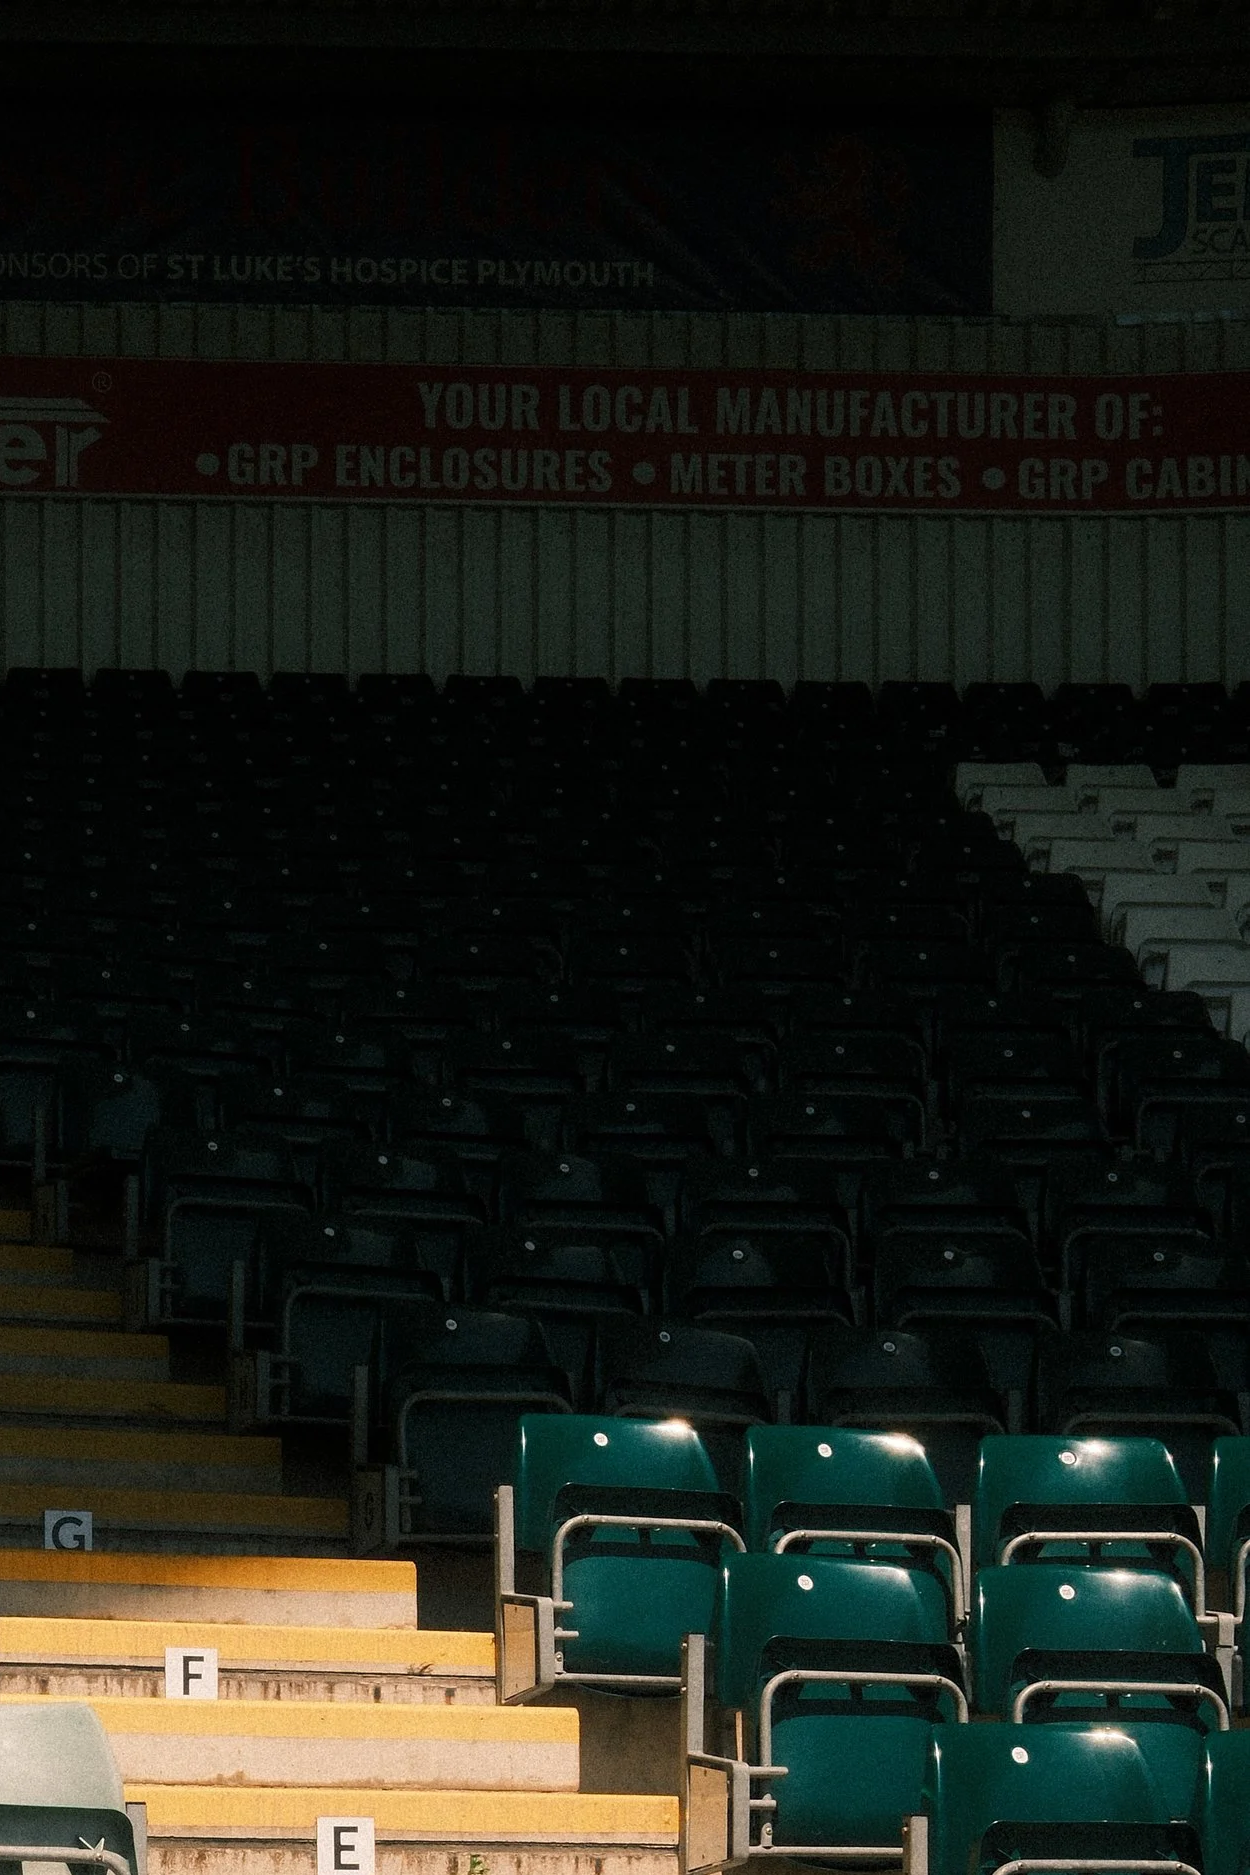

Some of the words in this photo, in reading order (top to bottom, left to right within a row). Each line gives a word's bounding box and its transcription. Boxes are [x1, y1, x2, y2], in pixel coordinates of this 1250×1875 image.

[1133, 132, 1250, 260] JE
[117, 252, 159, 281] OF
[166, 253, 206, 282] ST
[213, 254, 321, 283] LUKE'S
[330, 256, 469, 286] HOSPICE
[477, 258, 655, 288] PLYMOUTH
[416, 380, 542, 431] YOUR
[558, 383, 699, 435] LOCAL
[715, 385, 1078, 441] MANUFACTURER
[1094, 391, 1166, 440] OF:
[226, 442, 320, 487] GRP
[335, 444, 613, 494] ENCLOSURES
[669, 452, 808, 498] METER
[823, 454, 963, 499] BOXES
[1017, 456, 1109, 501] GRP
[52, 1516, 85, 1550] G
[182, 1655, 204, 1696] F
[333, 1826, 360, 1871] E
